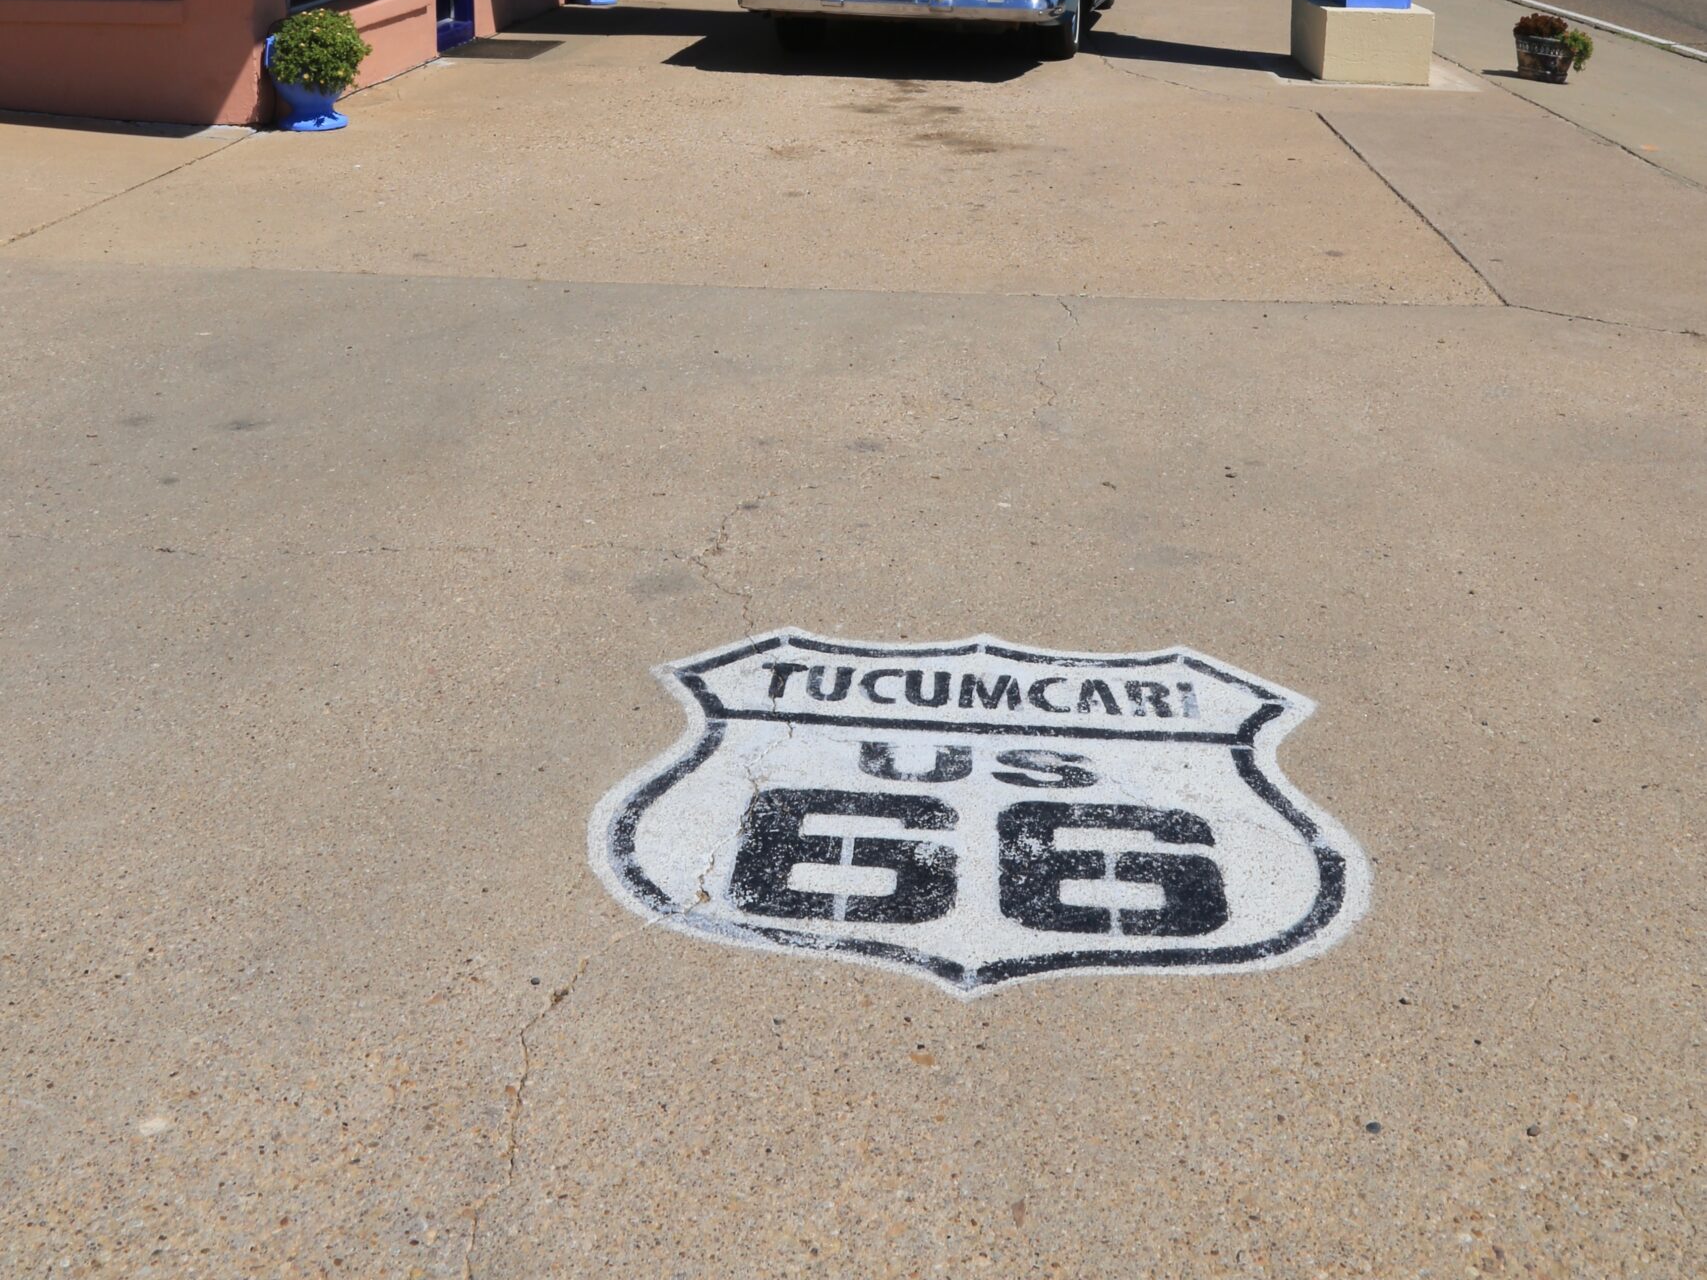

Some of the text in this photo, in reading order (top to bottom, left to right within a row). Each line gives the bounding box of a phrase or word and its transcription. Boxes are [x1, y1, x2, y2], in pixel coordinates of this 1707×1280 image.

[761, 661, 1199, 719] TUCUMCARI
[857, 740, 1099, 789] US
[727, 788, 1230, 937] 66
